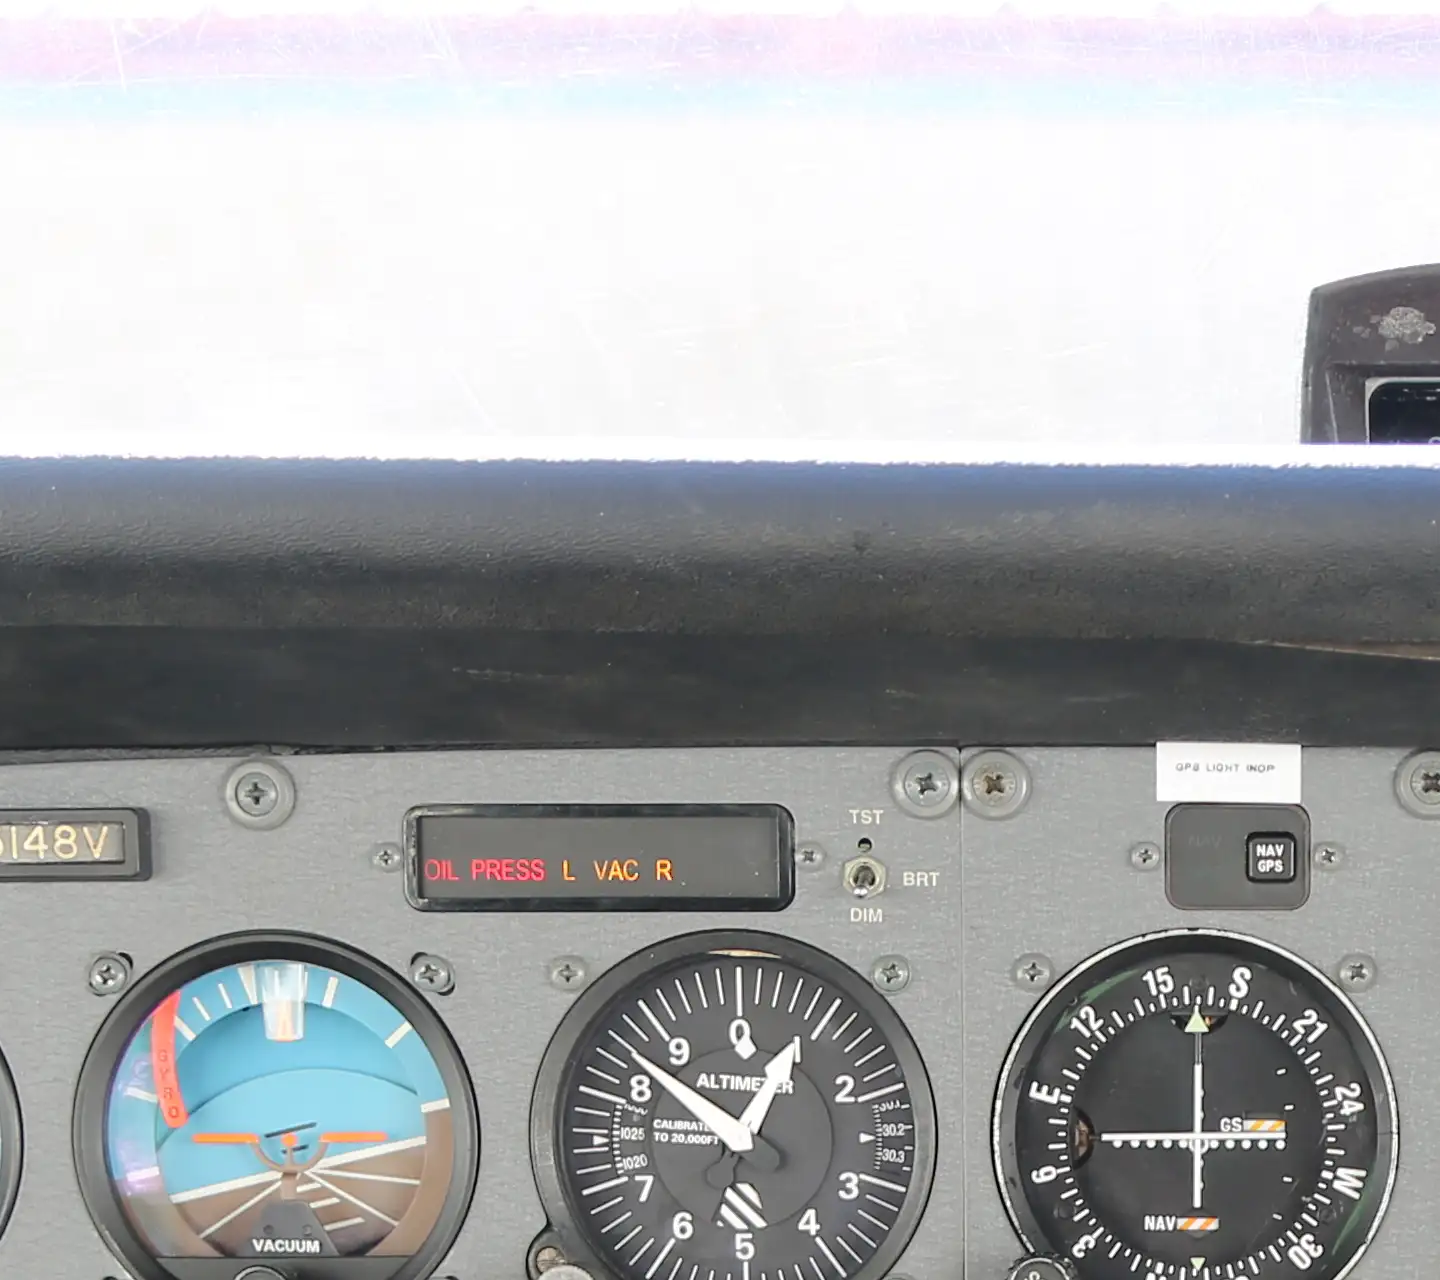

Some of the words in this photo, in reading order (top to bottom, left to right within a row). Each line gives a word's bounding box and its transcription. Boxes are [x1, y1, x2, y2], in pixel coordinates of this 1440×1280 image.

[1175, 762, 1200, 772] GPS
[1205, 762, 1240, 773] LIGHT
[1246, 764, 1276, 774] INOP
[848, 809, 884, 825] TST
[1256, 843, 1284, 857] NAV
[425, 858, 460, 881] OIL
[470, 858, 547, 882] PRESS
[561, 860, 577, 882] L
[596, 859, 640, 881] VAC
[655, 859, 673, 880] R
[1257, 859, 1284, 873] GPS
[903, 871, 940, 887] BRT
[850, 907, 883, 923] DIM
[252, 1238, 320, 1253] VACUUM
